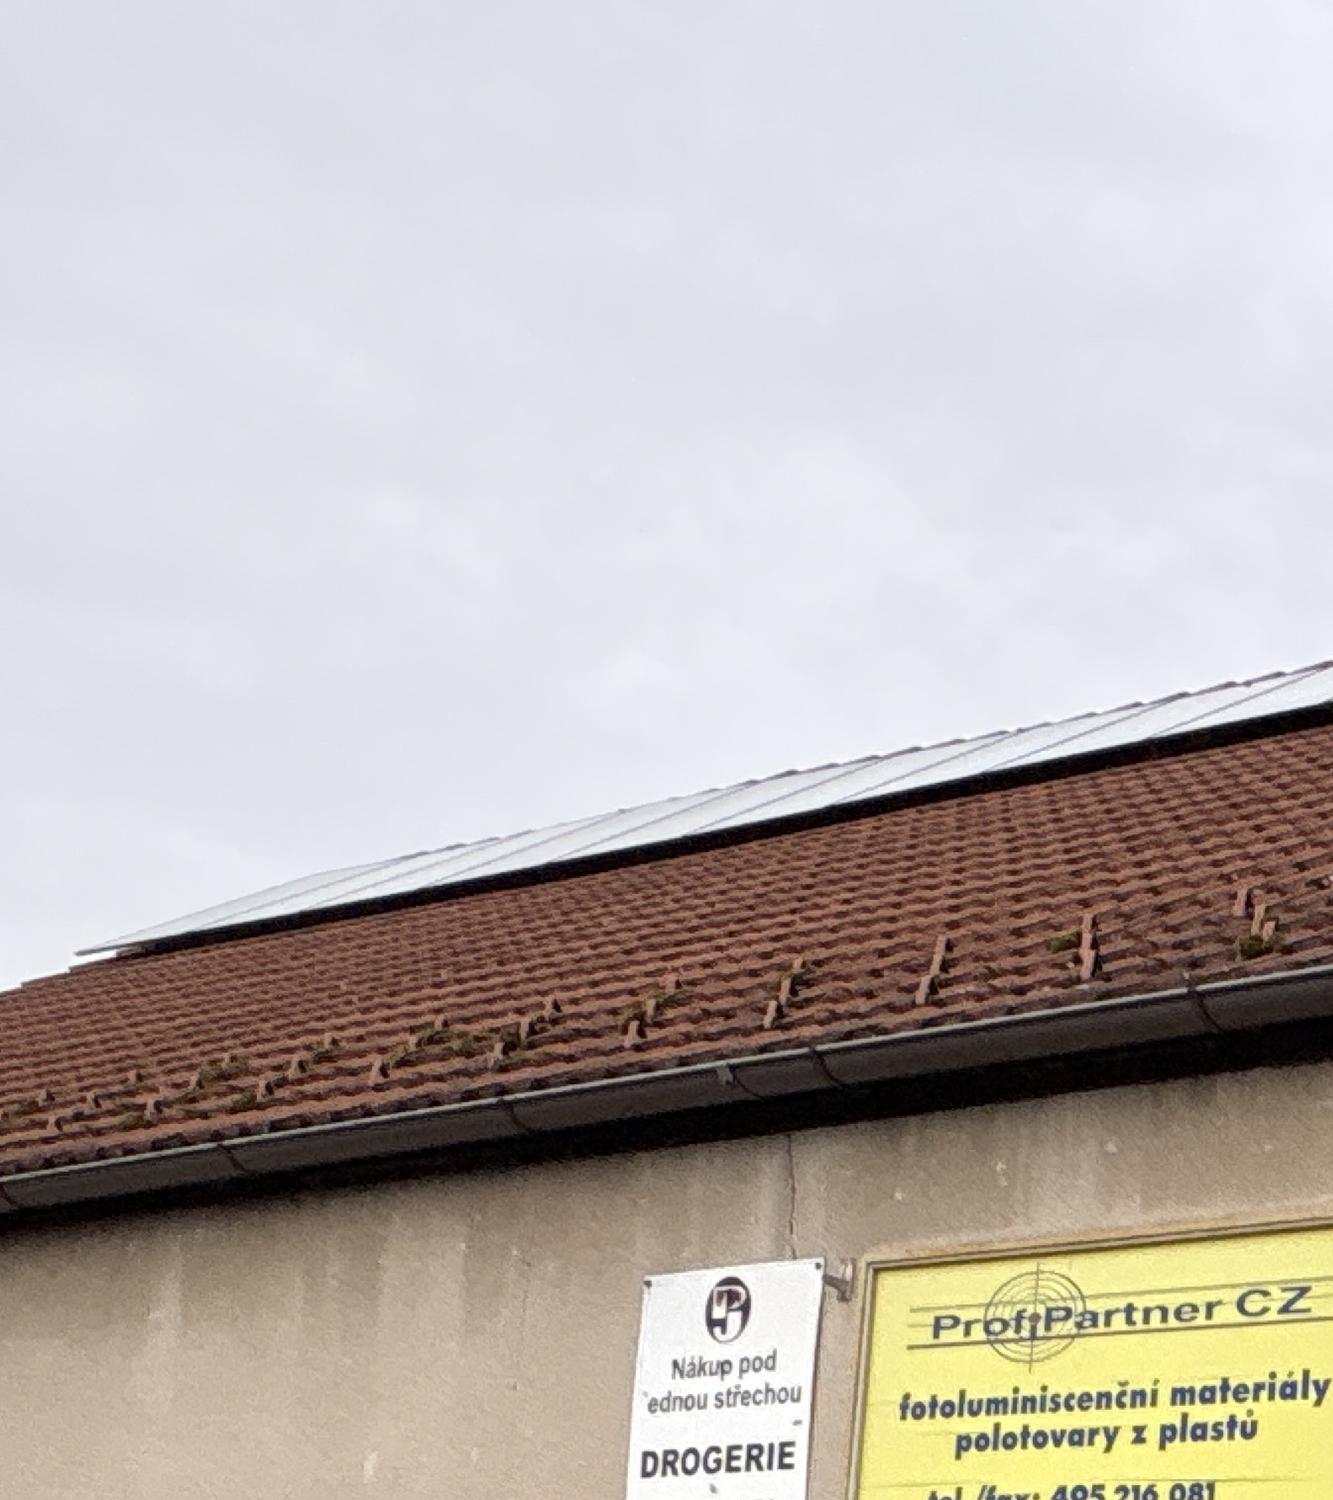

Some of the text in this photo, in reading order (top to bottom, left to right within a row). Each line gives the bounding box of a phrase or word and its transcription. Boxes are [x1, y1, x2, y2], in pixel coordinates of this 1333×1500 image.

[931, 1285, 1313, 1341] ProfiPartner CZ
[671, 1348, 778, 1382] Nákup pod
[643, 1382, 803, 1415] ednou střechou
[899, 1368, 1333, 1421] fotoluminiscenční materiály
[954, 1409, 1260, 1461] polotovary z plastů
[640, 1441, 797, 1480] DROGERIE
